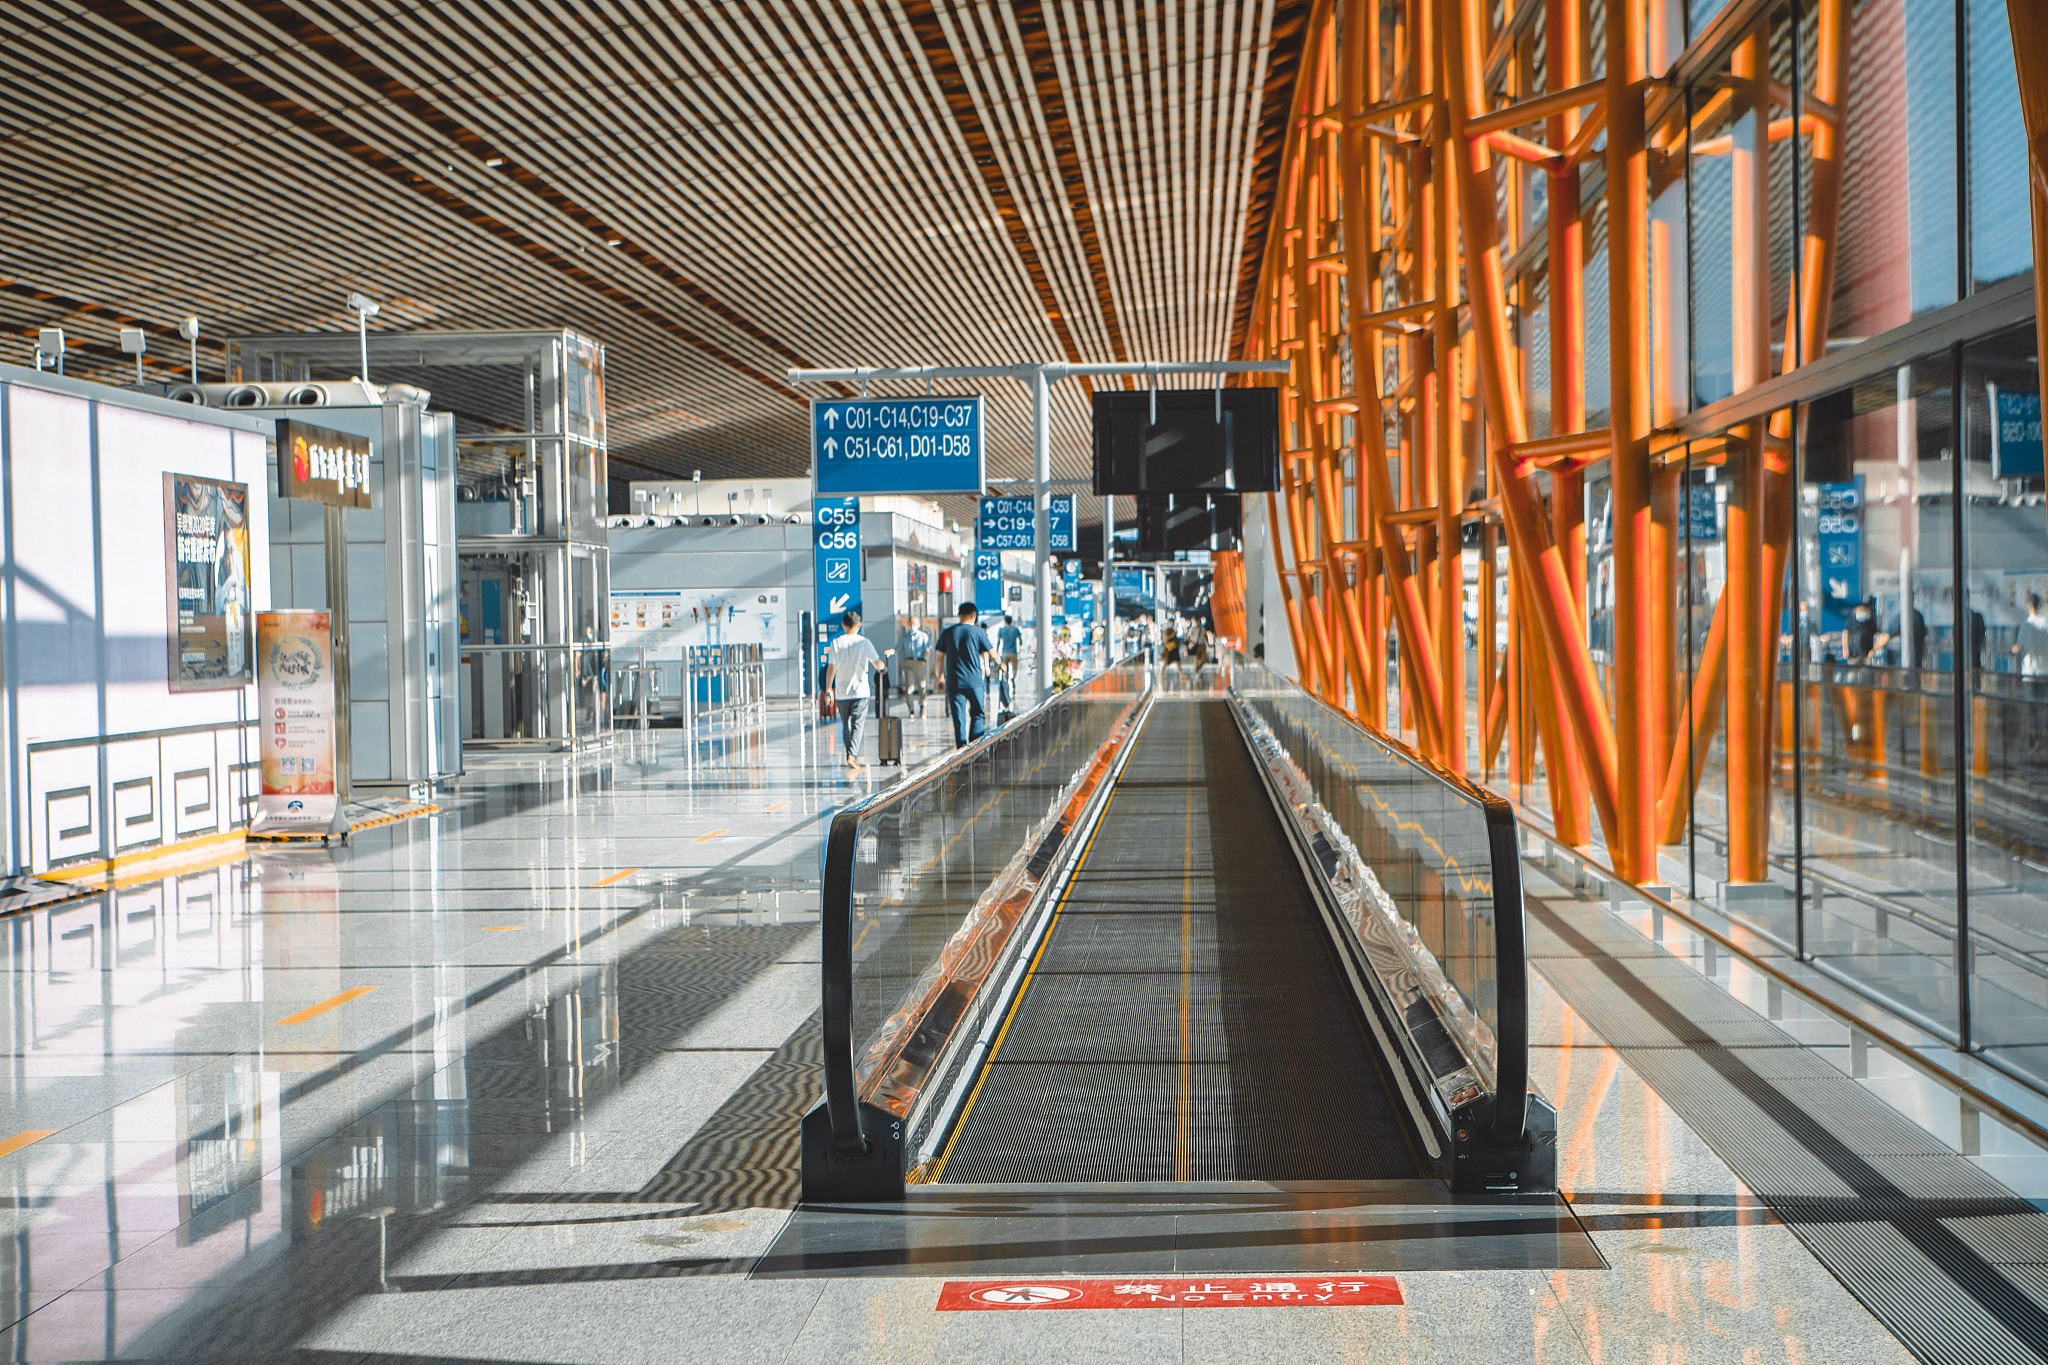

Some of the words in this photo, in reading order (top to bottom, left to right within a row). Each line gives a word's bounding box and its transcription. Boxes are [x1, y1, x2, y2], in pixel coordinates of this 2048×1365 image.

[818, 507, 856, 525] C55
[819, 532, 857, 549] C56
[978, 555, 998, 567] C13
[978, 569, 999, 581] C14
[1113, 1281, 1370, 1295] 禁止通行
